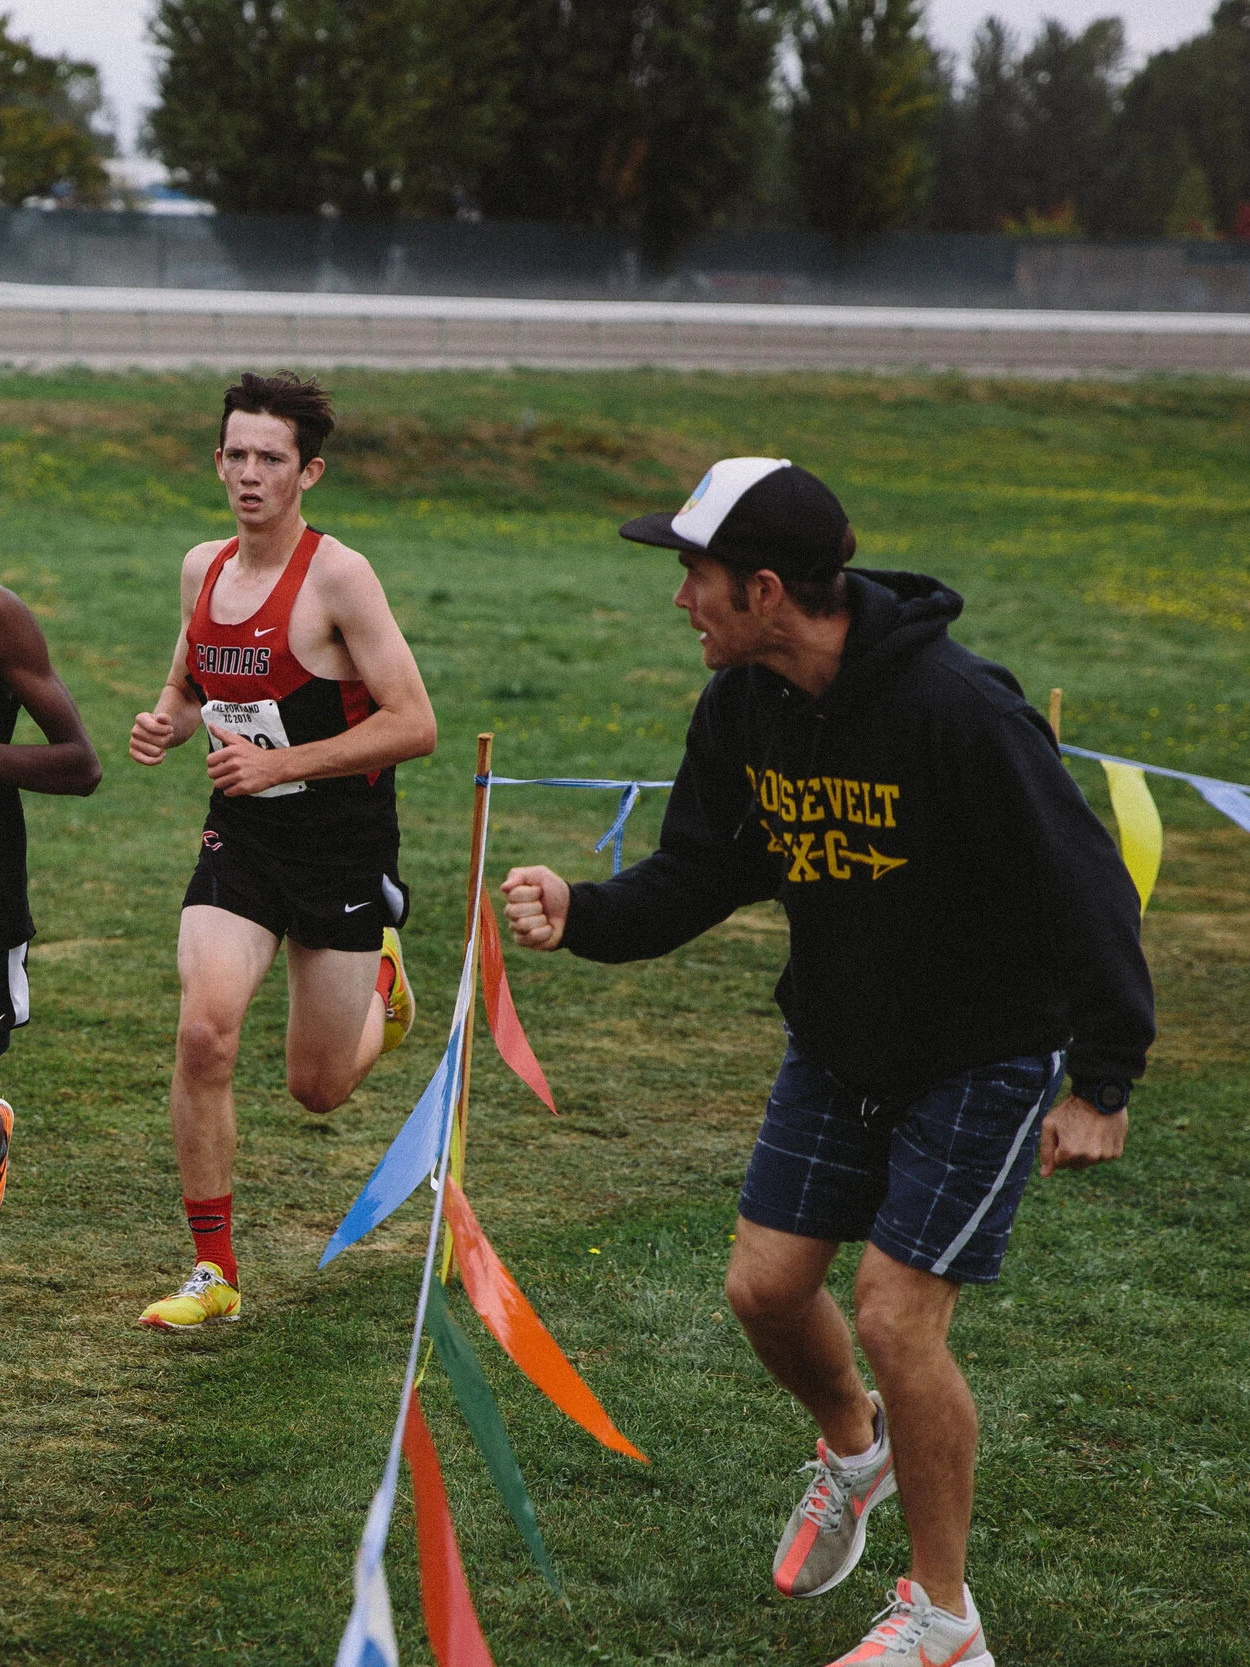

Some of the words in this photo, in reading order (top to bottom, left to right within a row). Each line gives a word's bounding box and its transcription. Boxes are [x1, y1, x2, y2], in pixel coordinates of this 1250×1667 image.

[196, 644, 271, 676] CAMAS
[234, 714, 252, 723] 2018
[745, 764, 900, 827] OSEVELT
